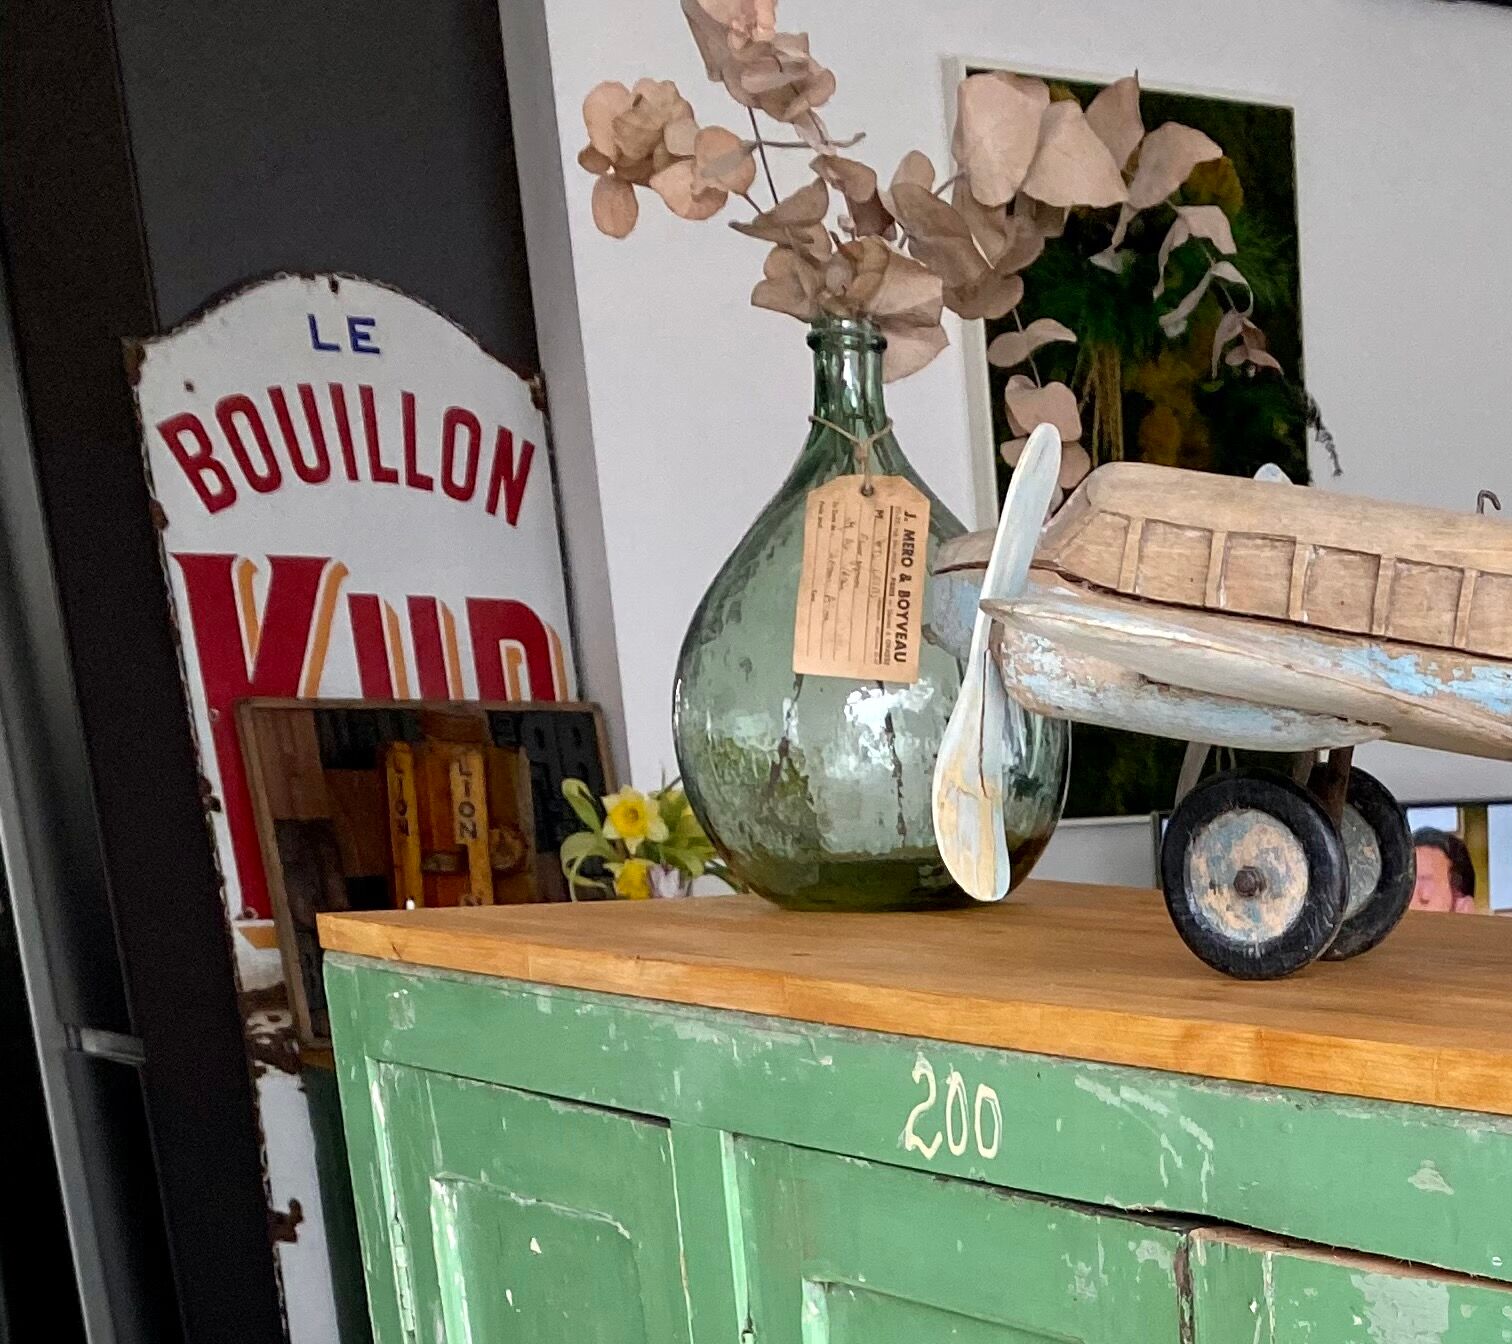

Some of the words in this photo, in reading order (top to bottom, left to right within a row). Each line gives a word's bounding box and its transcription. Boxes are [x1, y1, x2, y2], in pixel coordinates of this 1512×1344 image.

[308, 313, 381, 355] LE
[156, 382, 537, 527] BOUILLON
[901, 528, 916, 569] MERO
[893, 589, 911, 664] BOYVEAU
[458, 756, 478, 839] LION
[904, 1054, 1003, 1160] 200
